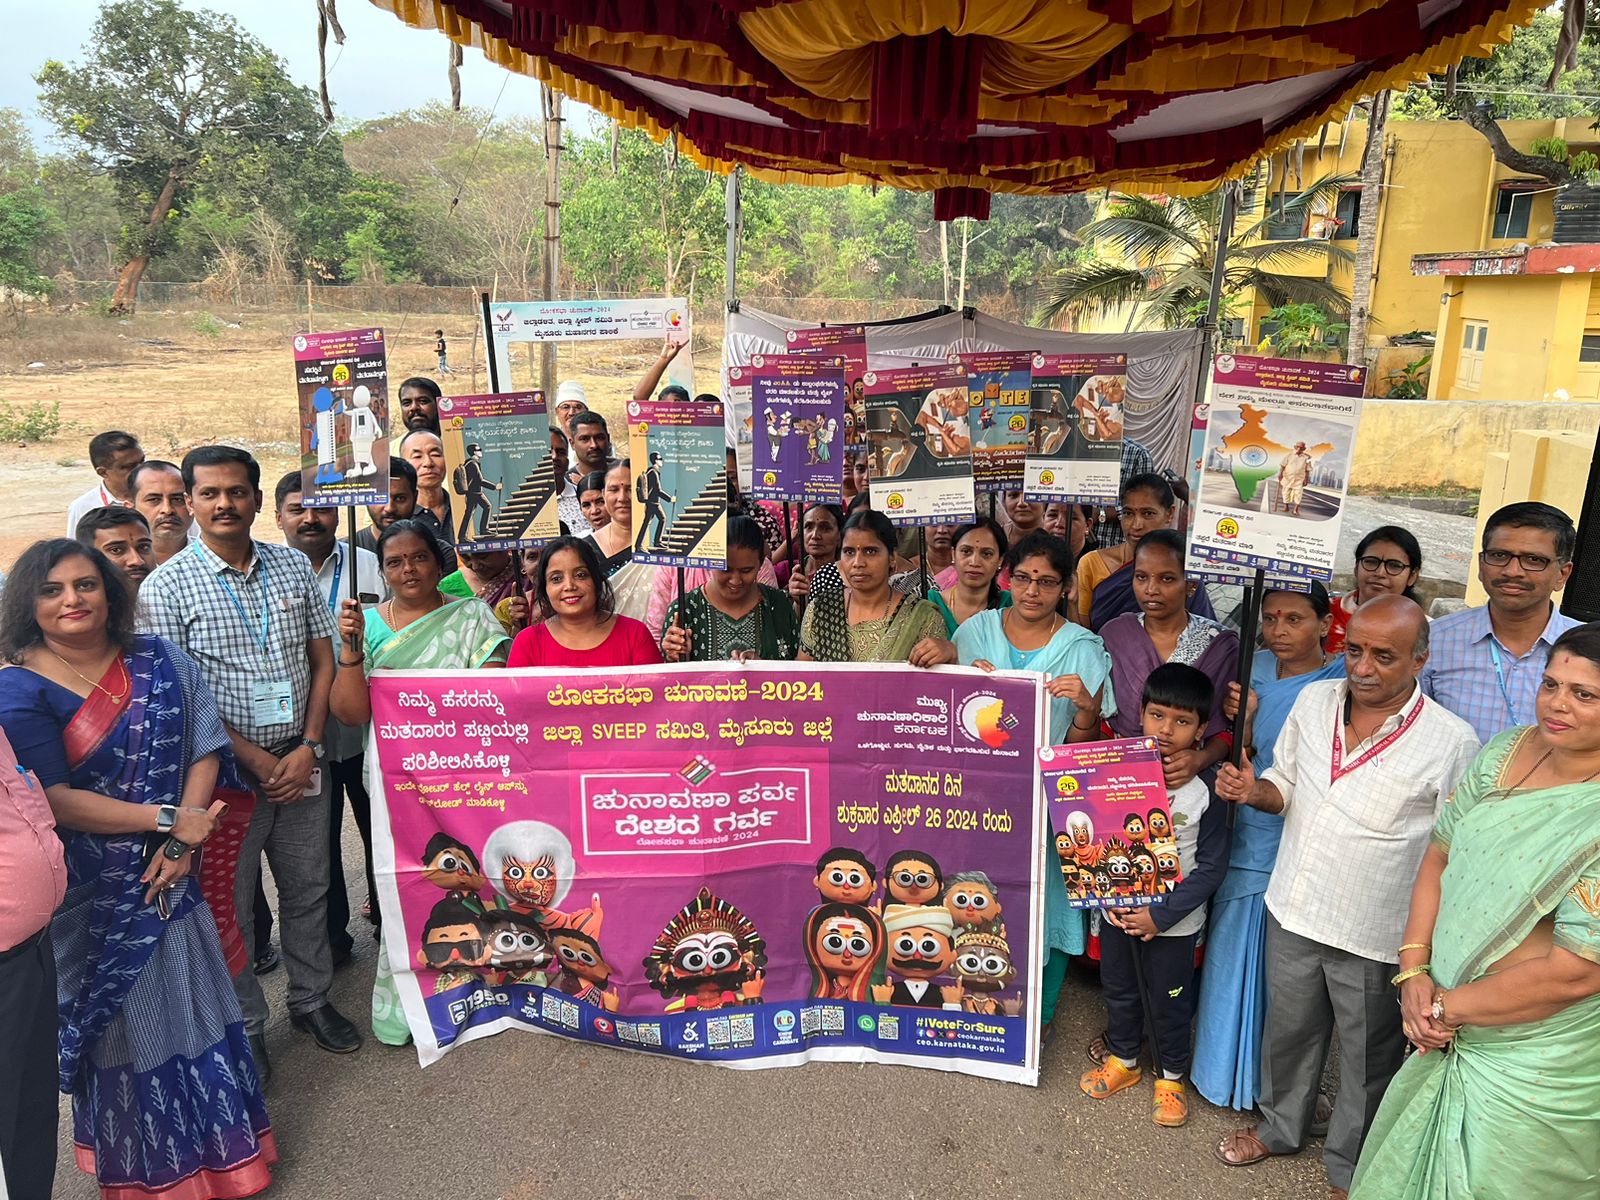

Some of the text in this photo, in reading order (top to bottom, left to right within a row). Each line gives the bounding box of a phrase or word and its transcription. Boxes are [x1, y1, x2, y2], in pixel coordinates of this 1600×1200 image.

[335, 371, 347, 380] 26
[1011, 420, 1023, 428] 26
[1042, 474, 1052, 482] 26
[1220, 524, 1235, 535] 26
[547, 678, 824, 707] ಲೋಕಸಭಾ ಚುನಾವಣೆ-2024
[398, 689, 506, 716] ನಿಮ್ಮ ಹೆಸರನ್ನು
[917, 695, 948, 714] ಮುಖ್ಯ
[857, 710, 948, 724] ಚುನಾವಣಾಧಿಕಾರಿ
[380, 719, 529, 746] ಮತದಾರರ ಪಟ್ಟಿಯಲ್ಲಿ
[543, 716, 833, 746] ಜಿಲ್ಲಾ SVEEP ಸಮಿತಿ, ಮೈಸೂರು ಜಿಲ್ಲೆ
[894, 723, 948, 736] ಕರ್ನಾಟಕ
[402, 750, 511, 777] ಪರಿಶೀಲಿಸಿಕೊಳ್ಳಿ
[885, 769, 963, 797] ಮತದಾನದ ದಿನ
[1060, 782, 1075, 791] 26
[592, 781, 799, 810] ಚುನಾವಣಾ ಪರ್ವ
[615, 807, 778, 836] ದೇಶದ ಗರ್ವ
[836, 800, 1012, 834] ಶುಕ್ರವಾರ ಎಪ್ರೀಲ್ 26 2024 ರಂದು
[636, 830, 760, 846] ಲೋಕಸಭಾ ಚುನಾವಣೆ 2024
[467, 989, 509, 1009] 1950
[916, 1017, 1005, 1035] #IVoteForSure
[916, 1039, 1005, 1054] ceo.karnataka.gov.in
[957, 1032, 1005, 1044] ceokarnataka
